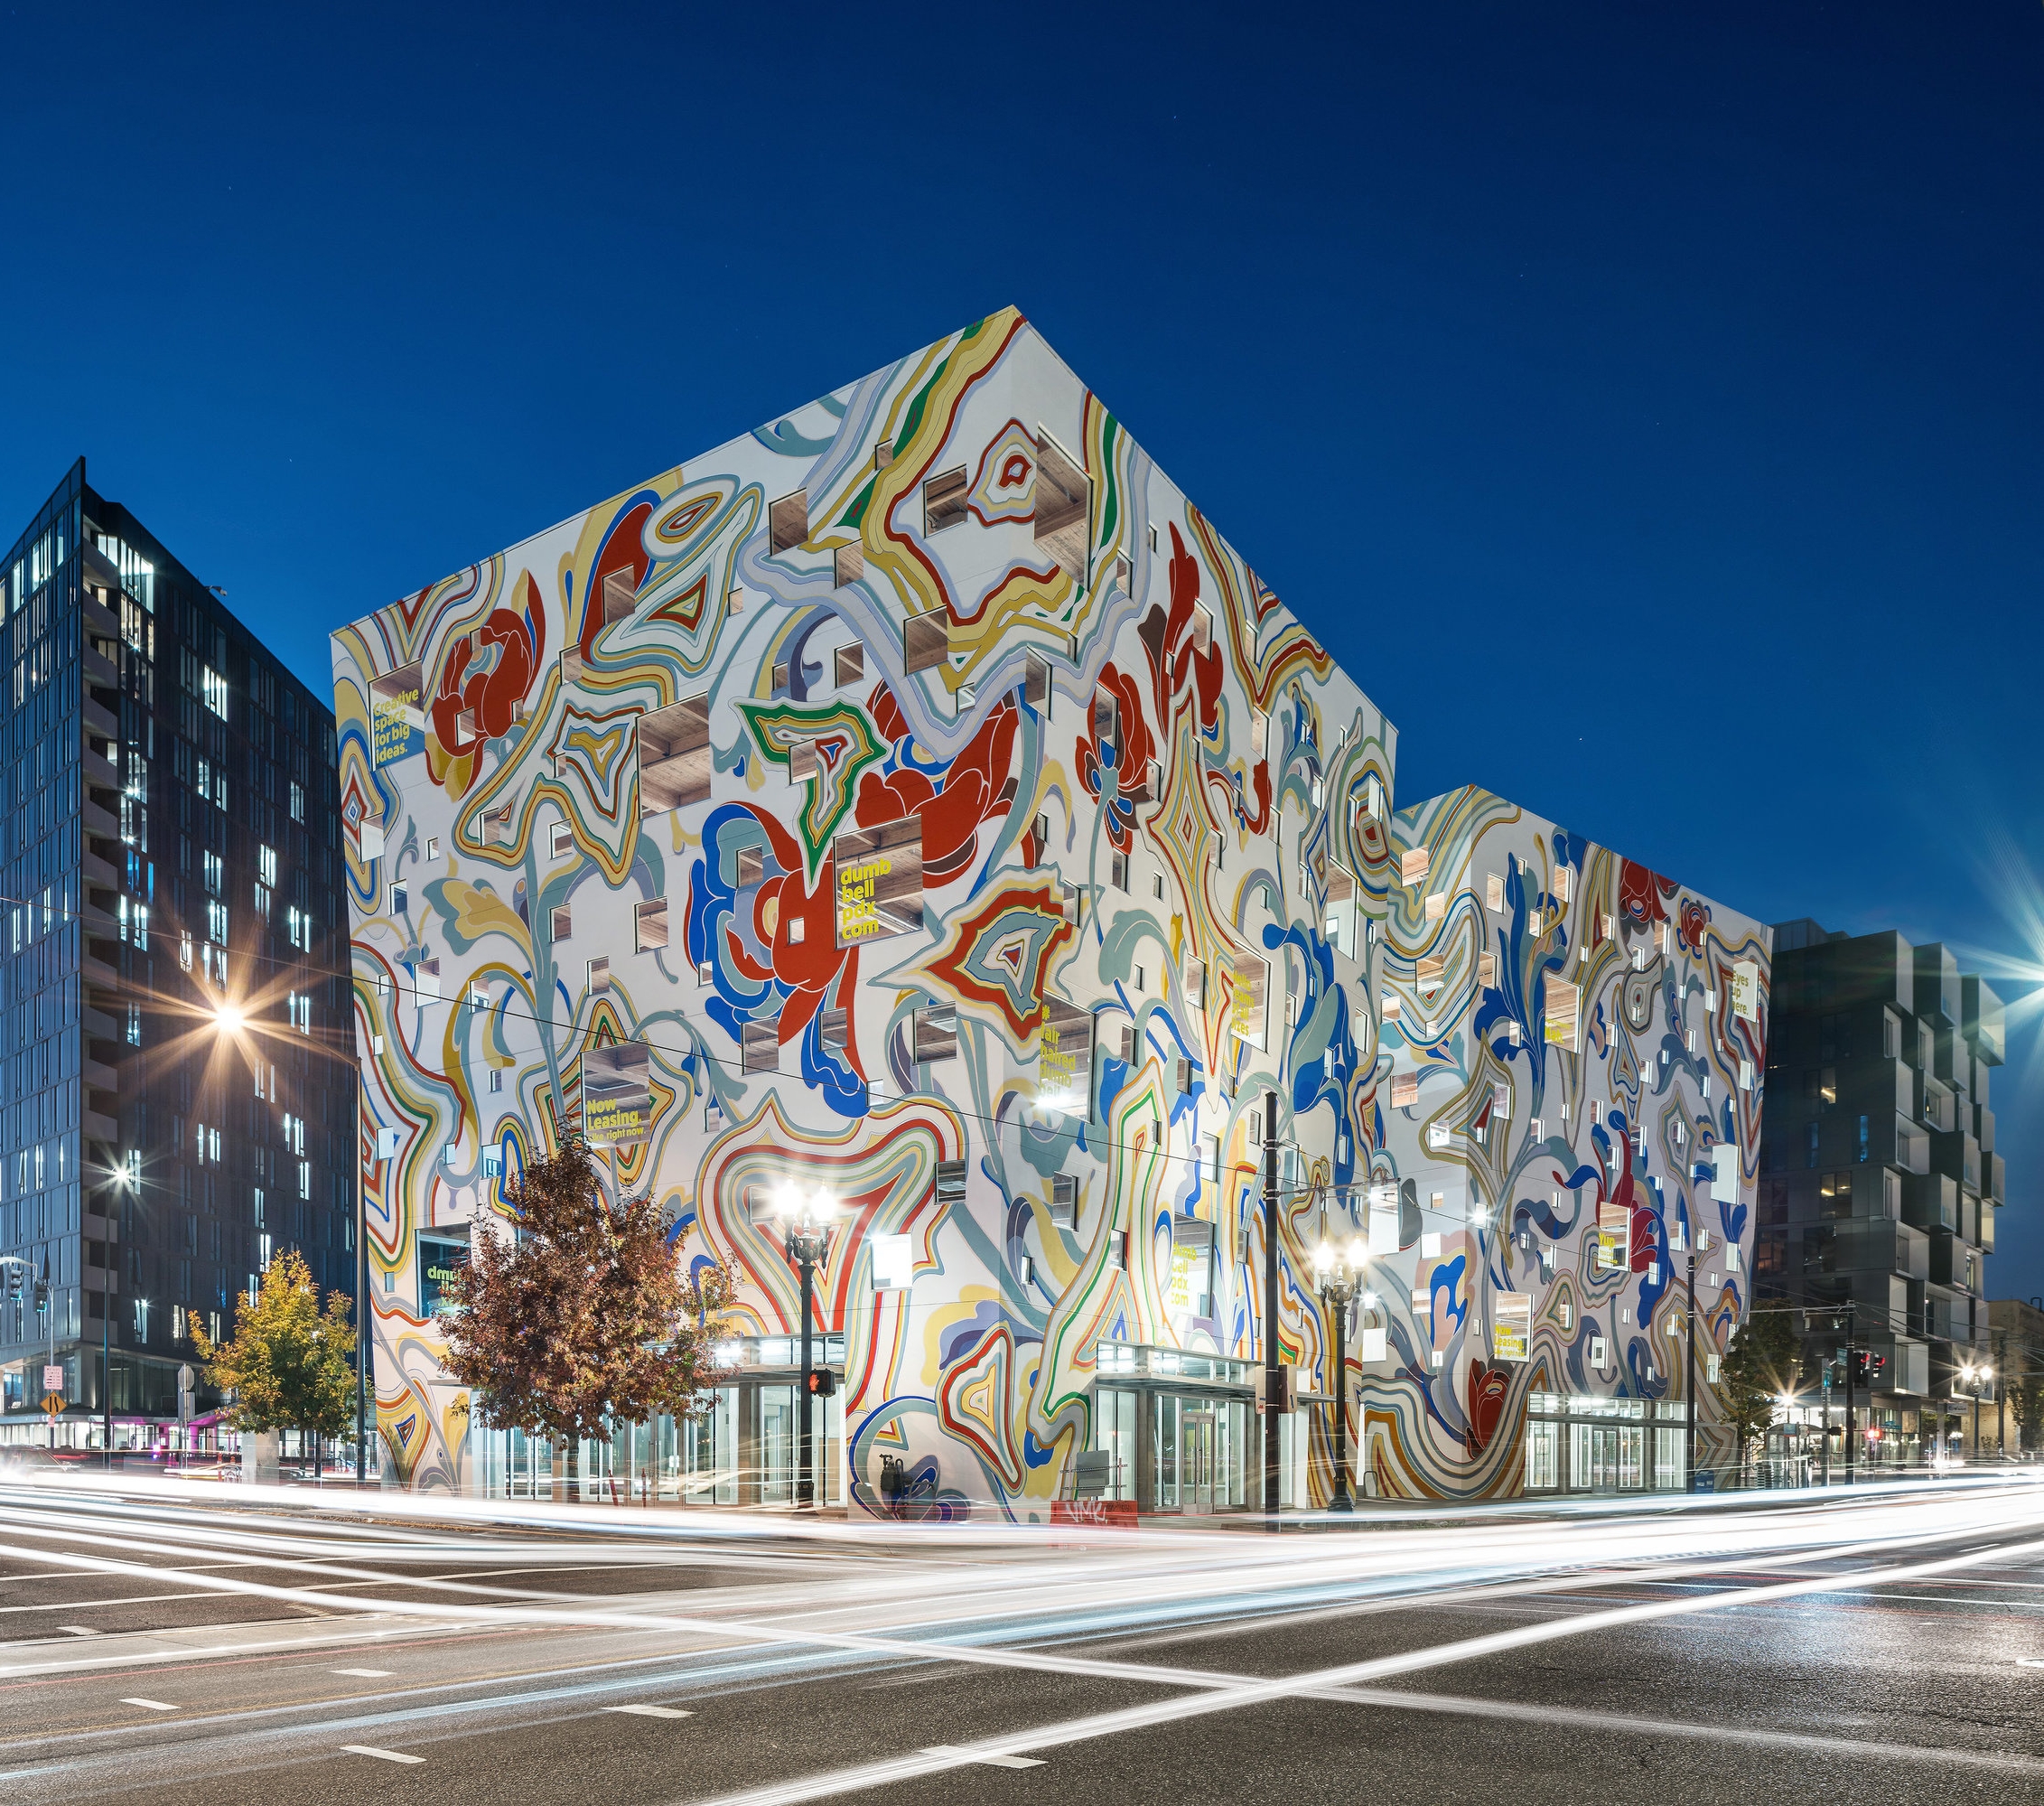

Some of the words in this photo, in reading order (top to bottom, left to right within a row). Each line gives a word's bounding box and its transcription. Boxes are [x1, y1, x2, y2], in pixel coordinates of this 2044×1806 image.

[373, 688, 419, 716] Creative
[374, 708, 406, 733] space
[375, 731, 391, 748] for
[391, 723, 410, 742] big
[376, 743, 408, 764] ideas.
[840, 857, 892, 885] dumb
[842, 878, 875, 903] bell
[842, 899, 881, 925] pdx.
[842, 919, 879, 940] com
[1041, 1022, 1060, 1045] fair
[1041, 1041, 1076, 1071] haired
[1040, 1062, 1072, 1089] dumb
[587, 1098, 617, 1115] Now
[587, 1109, 642, 1131] Leasing.
[607, 1128, 625, 1141] right
[1599, 1232, 1616, 1249] Yup
[1495, 1324, 1513, 1335] Now
